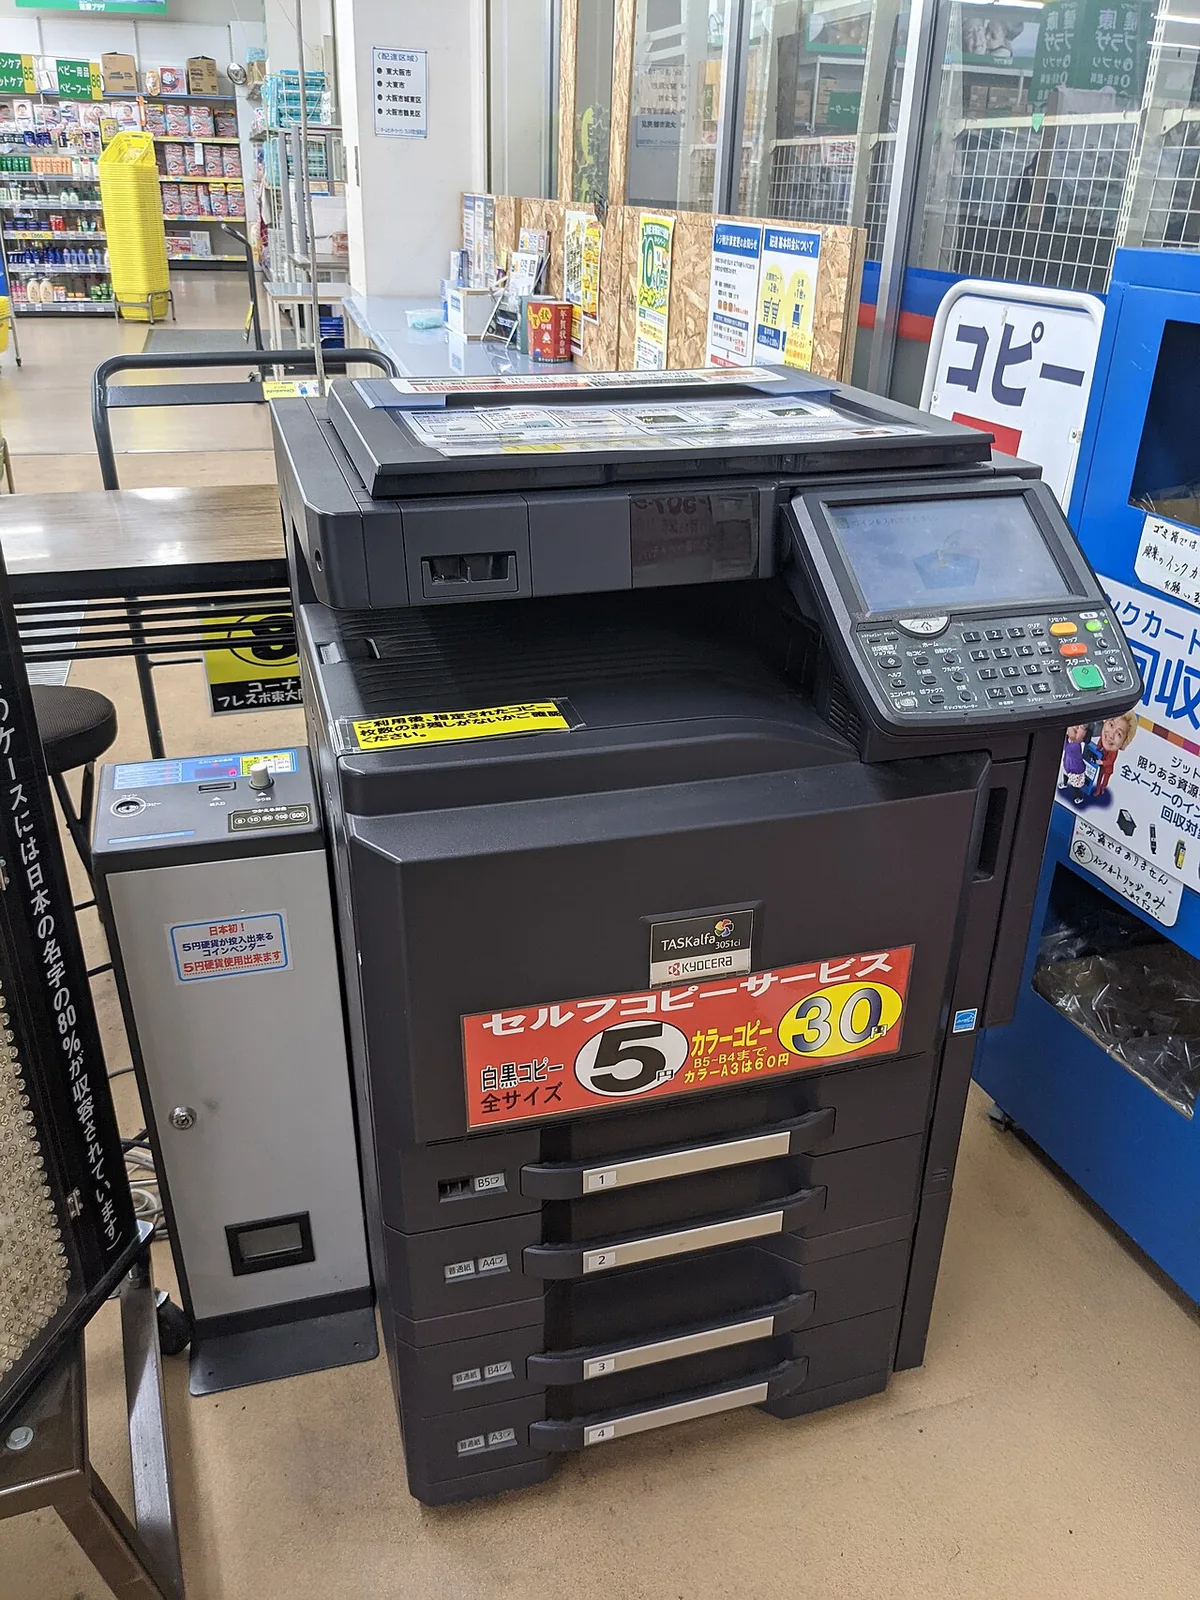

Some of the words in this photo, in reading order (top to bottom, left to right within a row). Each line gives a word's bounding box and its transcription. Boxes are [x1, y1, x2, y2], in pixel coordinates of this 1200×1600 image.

[0, 59, 21, 69] ンケア
[58, 65, 90, 77] ベビー用品
[24, 67, 34, 80] 85
[386, 68, 412, 77] 東大阪市
[91, 74, 101, 88] 86
[386, 81, 405, 89] 大東市
[60, 83, 92, 95] ベビーフード
[386, 94, 422, 104] 大阪市城東区
[946, 321, 1085, 406] コピー
[993, 630, 999, 638] 2
[1015, 628, 1020, 636] 3
[1023, 646, 1028, 654] 6
[1066, 658, 1091, 666] スタート
[986, 669, 991, 677] 7
[1009, 667, 1015, 675] 8
[248, 678, 300, 693] コーナ
[358, 704, 552, 729] ご利用後、指定されたコピー
[360, 710, 562, 736] 枚数のお残しがないかご確認
[361, 730, 427, 743] ください。
[1137, 755, 1200, 797] 限りある資源
[1161, 805, 1200, 840] 回収対
[1079, 821, 1168, 886] ごみ箱ではありません
[209, 922, 245, 936] 日本初!
[182, 932, 274, 951] 5円硬貨が投入出来る
[661, 932, 716, 951] TASKalfa
[715, 938, 741, 950] 3051ci
[203, 943, 266, 957] コインベンダー
[183, 950, 281, 973] 5円硬貨使用出来ます
[682, 956, 733, 973] KYOCERA
[482, 953, 893, 1036] セルフコピーサービス
[690, 1020, 773, 1057] カラーコピー
[480, 1057, 565, 1093] 白黒コピー
[684, 1052, 789, 1084] カラーA3は60円
[480, 1081, 563, 1115] 全サイズ
[477, 1176, 491, 1188] B5
[598, 1174, 605, 1185] 1
[449, 1264, 472, 1275] 普通紙
[482, 1257, 495, 1268] A4
[598, 1255, 606, 1265] 2
[455, 1371, 477, 1382] 普通紙
[487, 1365, 500, 1375] B4
[598, 1362, 606, 1371] 3
[460, 1438, 481, 1450] 普通紙
[491, 1430, 503, 1441] A3
[597, 1428, 605, 1438] 4
